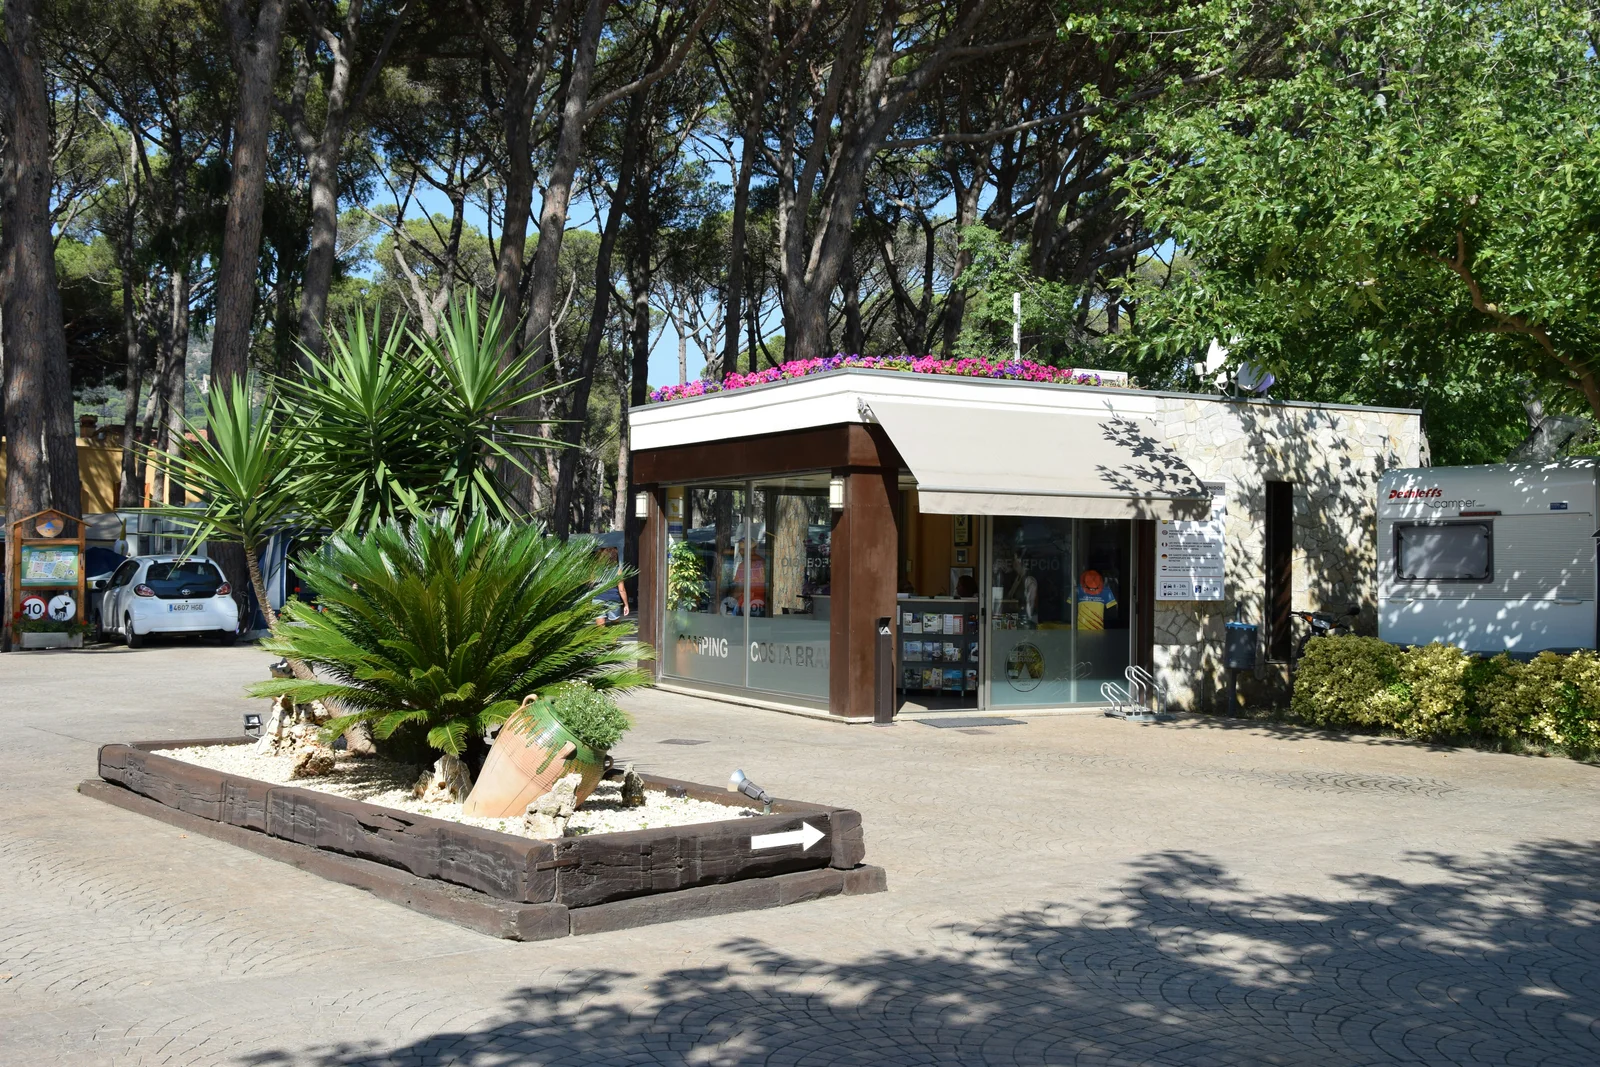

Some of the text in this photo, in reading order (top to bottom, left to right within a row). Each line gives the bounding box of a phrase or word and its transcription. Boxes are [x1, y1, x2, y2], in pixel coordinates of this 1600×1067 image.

[1388, 488, 1442, 499] Dethleffs
[1434, 500, 1476, 509] camper
[25, 603, 42, 615] 10
[750, 642, 792, 666] COSTA
